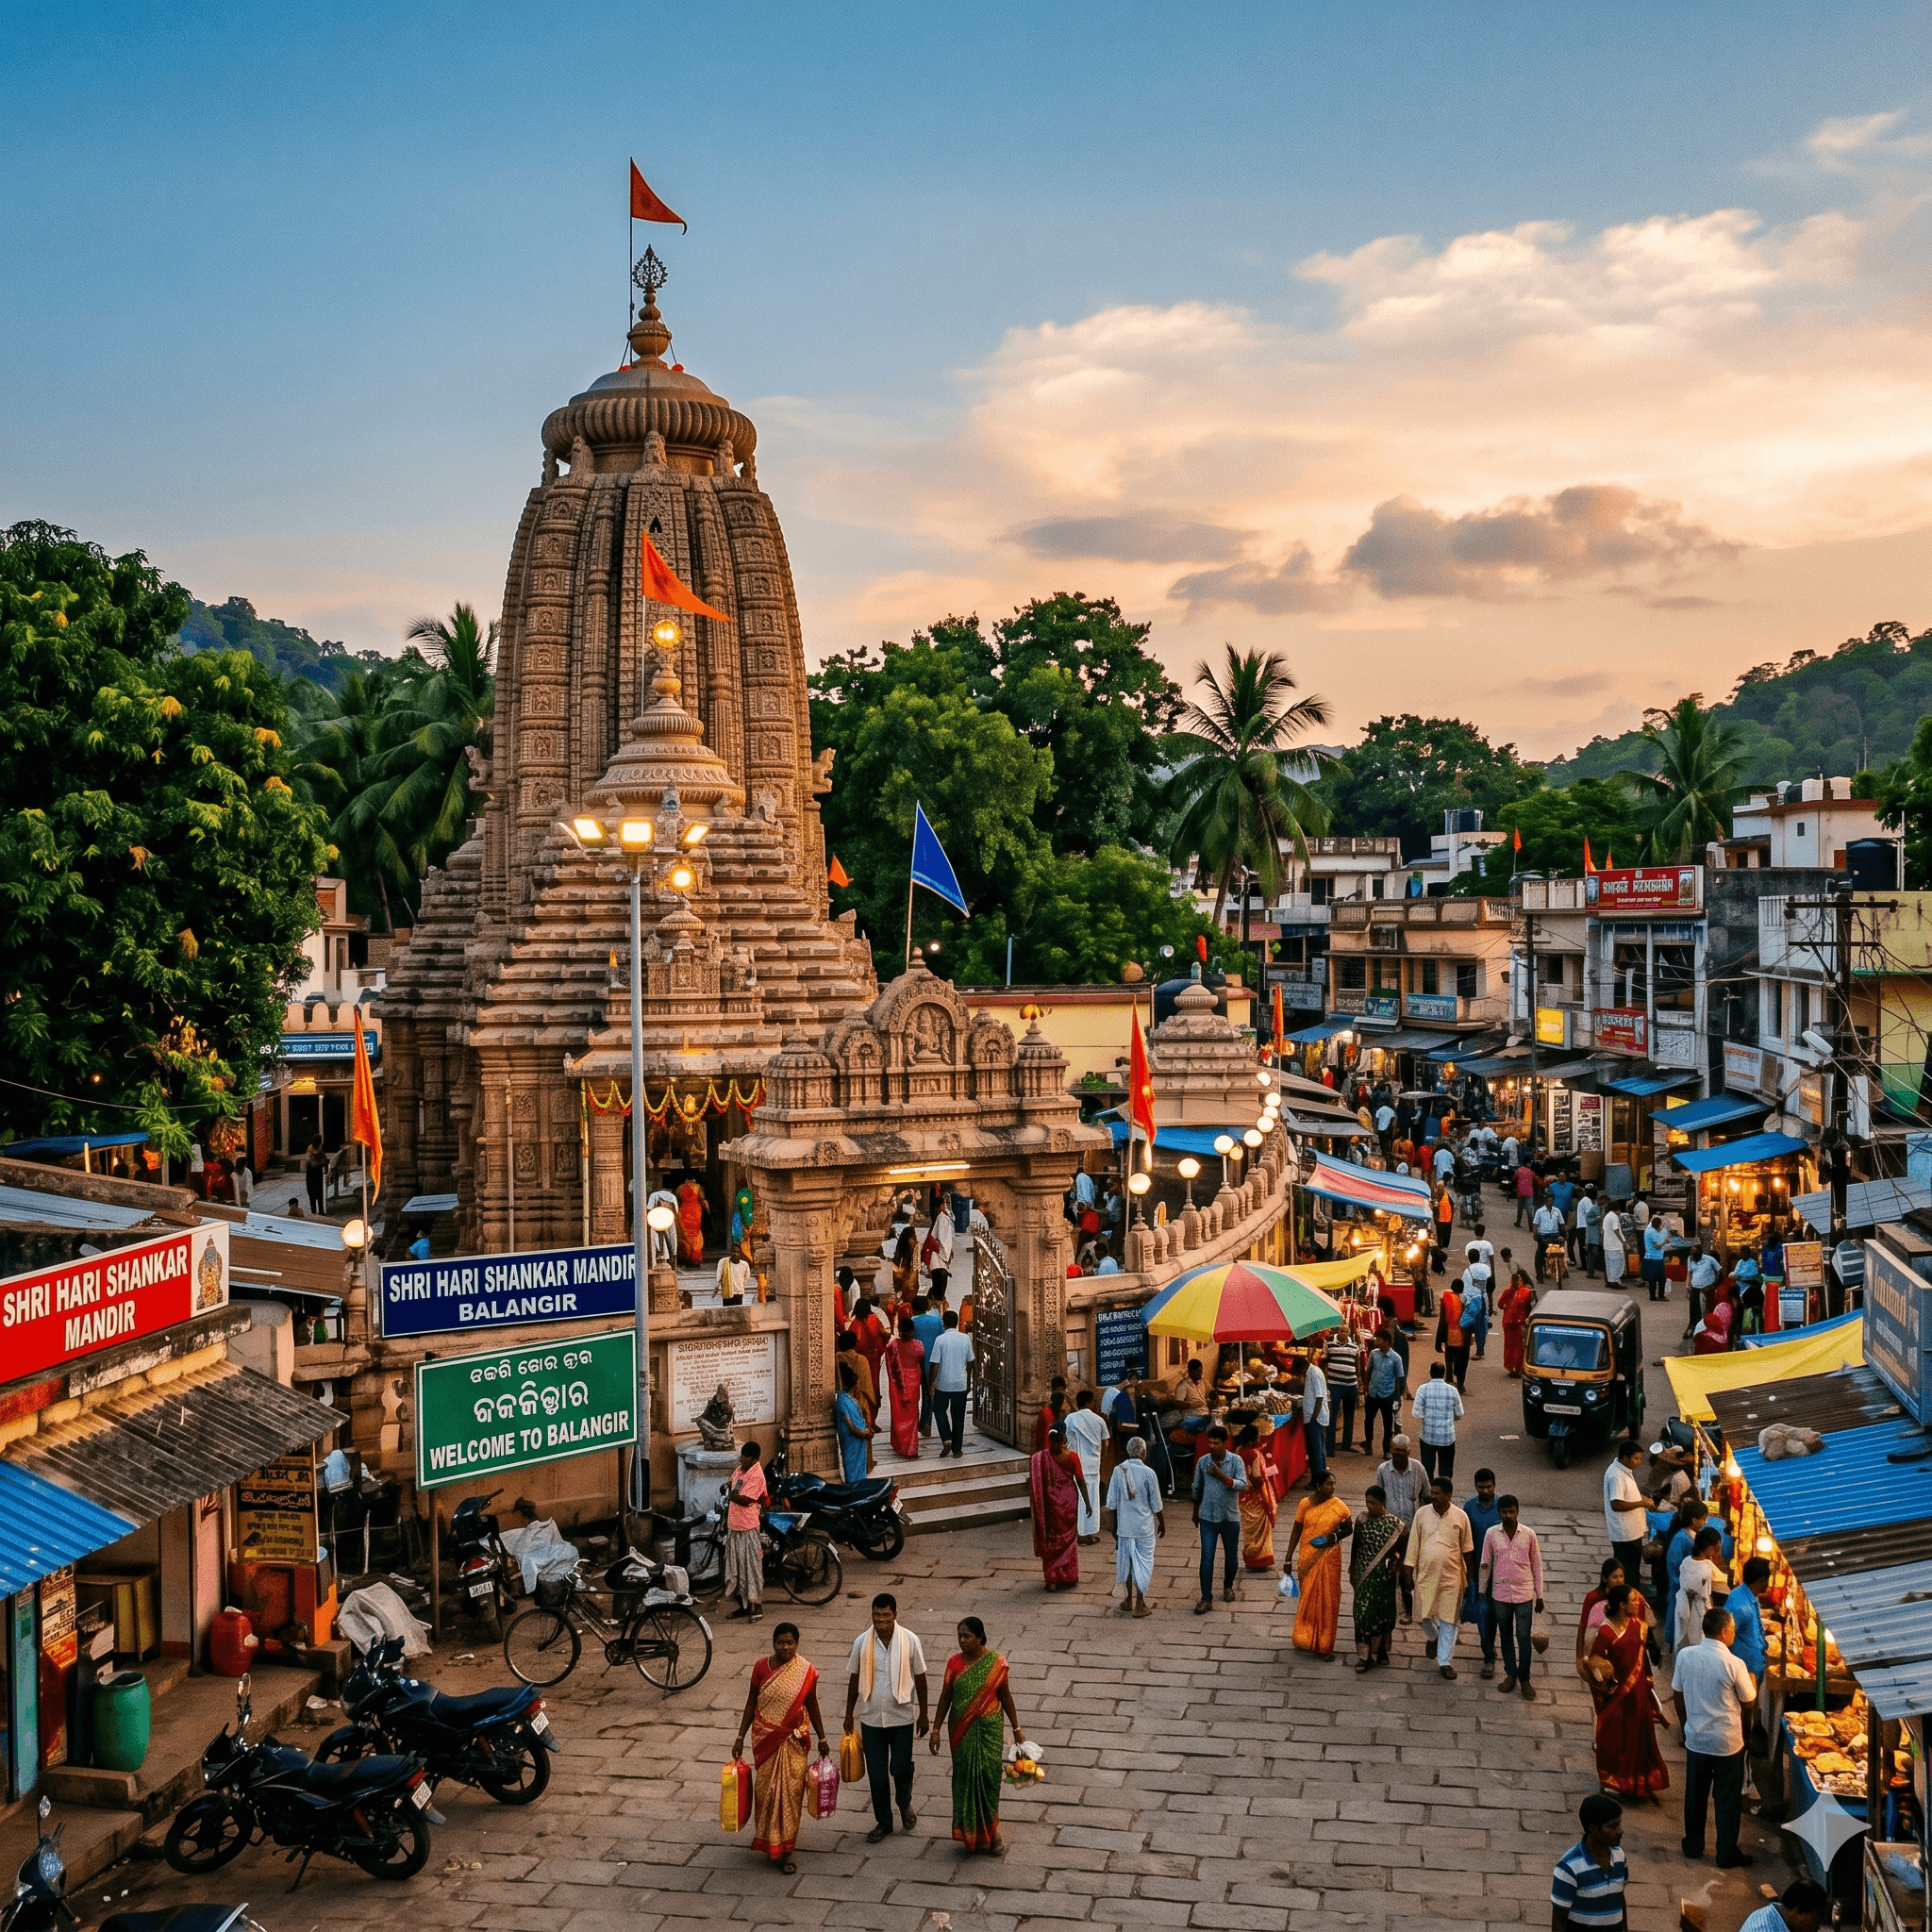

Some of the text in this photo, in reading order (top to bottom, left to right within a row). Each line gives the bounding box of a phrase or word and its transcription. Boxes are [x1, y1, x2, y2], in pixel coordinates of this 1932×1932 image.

[3, 1244, 188, 1327] SHRI HARI SHANKAR
[389, 1253, 635, 1303] SHRI HARI SHANKAR MANDIR
[65, 1300, 136, 1352] MANDIR
[458, 1293, 577, 1322] BALANGIR
[429, 1409, 629, 1471] WELCOME TO BALANGIR
